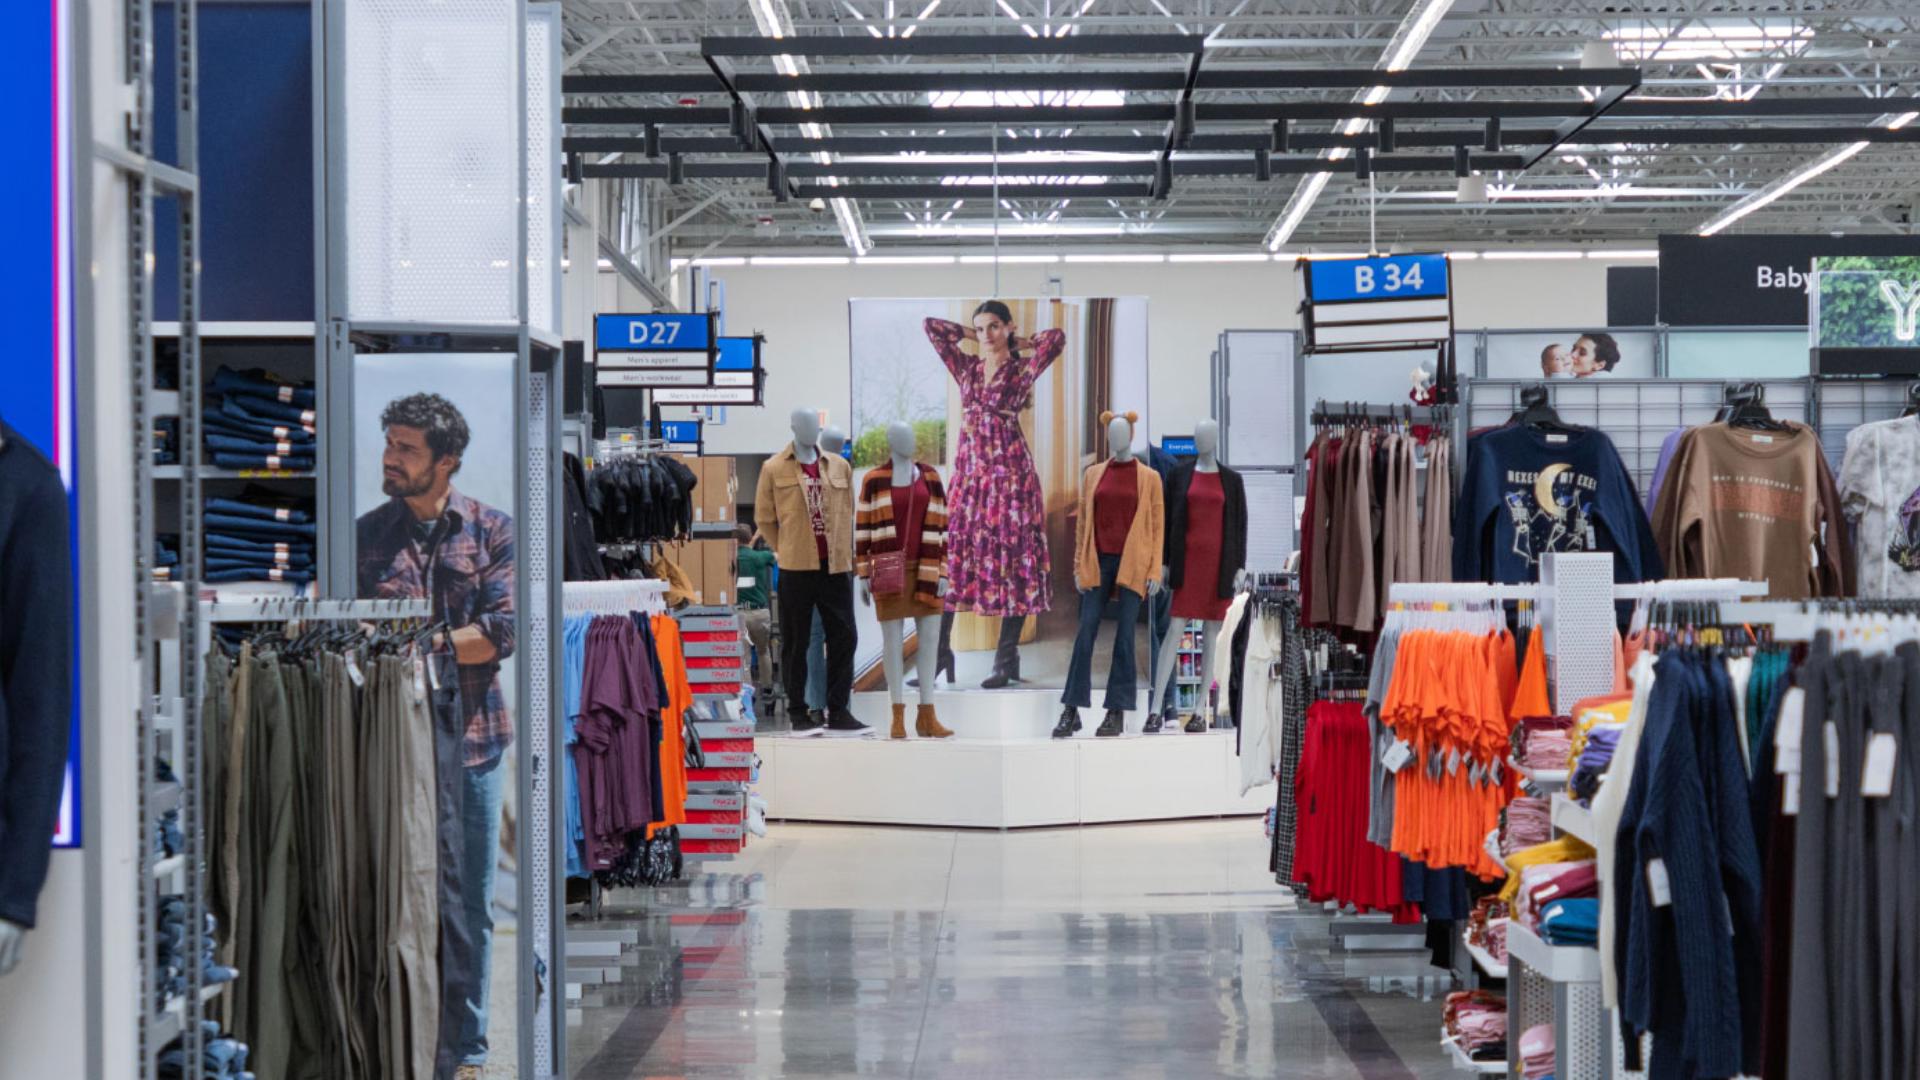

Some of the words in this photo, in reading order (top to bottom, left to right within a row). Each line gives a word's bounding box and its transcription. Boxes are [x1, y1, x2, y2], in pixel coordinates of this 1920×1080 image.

[1355, 265, 1375, 293] B
[1383, 262, 1424, 291] 34
[651, 356, 679, 364] apparel
[646, 374, 682, 382] workwear
